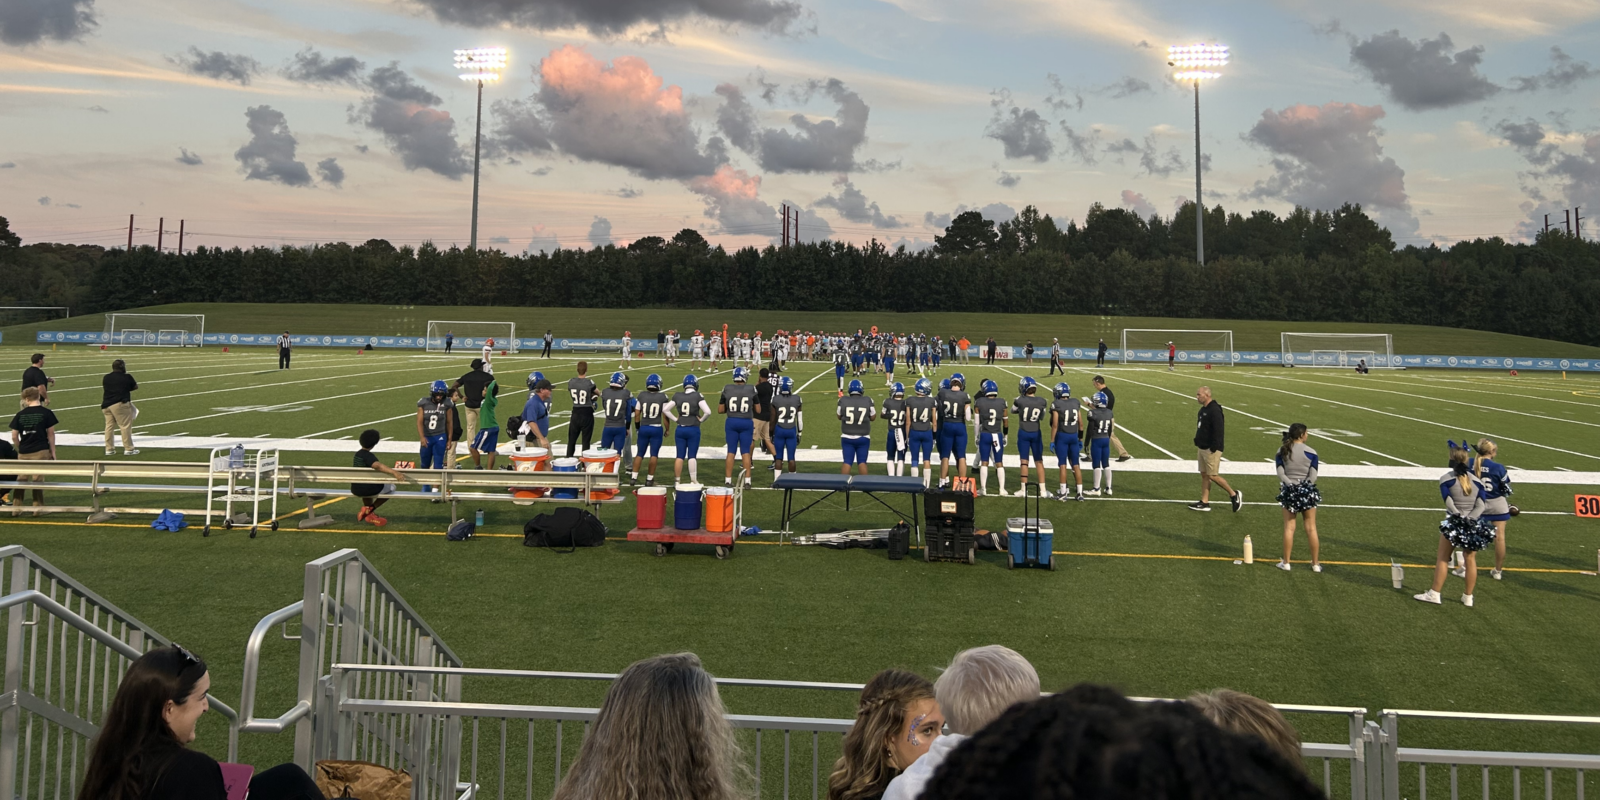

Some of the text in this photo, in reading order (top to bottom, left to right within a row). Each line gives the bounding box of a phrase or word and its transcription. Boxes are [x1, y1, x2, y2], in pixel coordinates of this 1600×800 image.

[571, 389, 587, 404] 58
[729, 397, 749, 412] 66
[606, 399, 622, 416] 17
[643, 403, 659, 418] 10
[682, 402, 690, 416] 9
[778, 407, 796, 423] 23
[846, 407, 866, 424] 57
[913, 408, 928, 422] 14
[944, 401, 958, 418] 21
[1023, 407, 1040, 421] 18
[429, 415, 438, 429] 8
[890, 410, 905, 426] 20
[988, 409, 996, 426] 3
[1064, 409, 1078, 426] 13
[1578, 497, 1600, 516] 30
